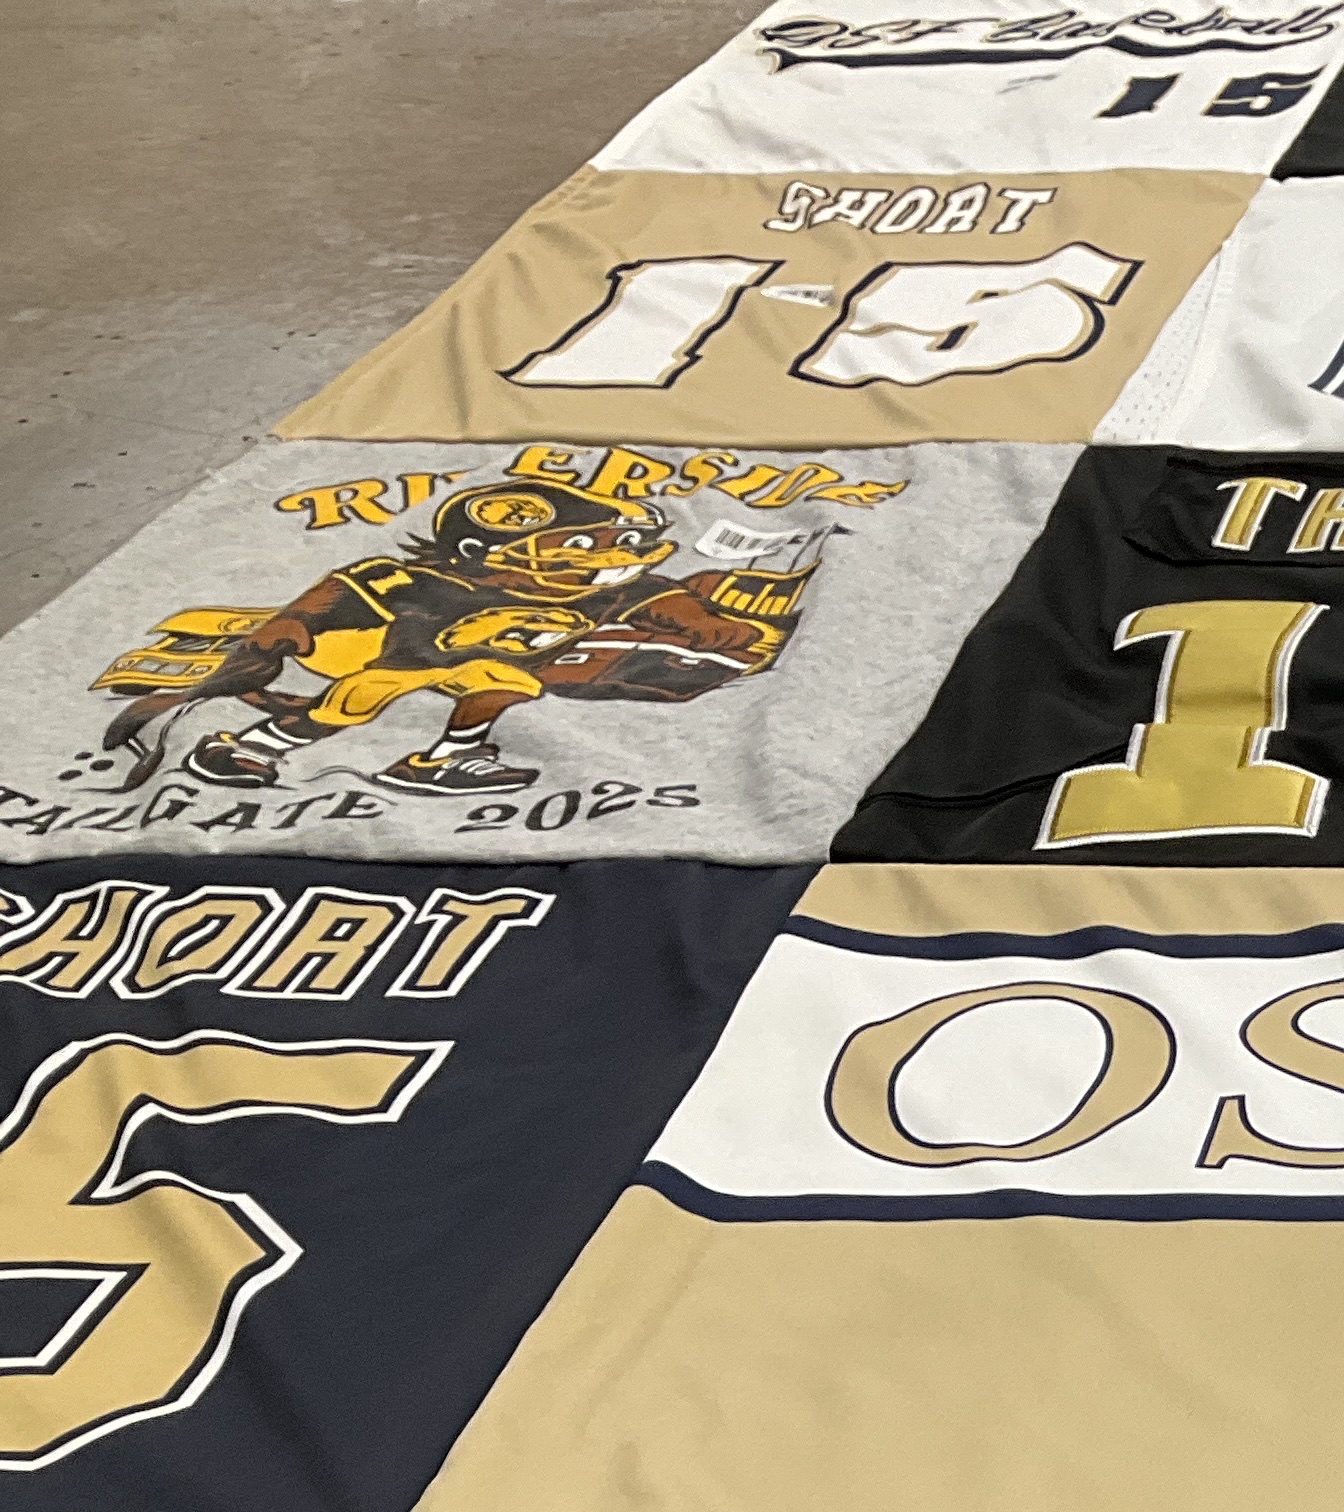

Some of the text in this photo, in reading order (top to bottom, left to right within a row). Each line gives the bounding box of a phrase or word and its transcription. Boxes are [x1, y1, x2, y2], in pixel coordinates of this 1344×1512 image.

[1092, 64, 1328, 118] 15
[764, 181, 1058, 235] SHORT
[454, 780, 701, 833] 2025
[0, 880, 557, 1002] HORT
